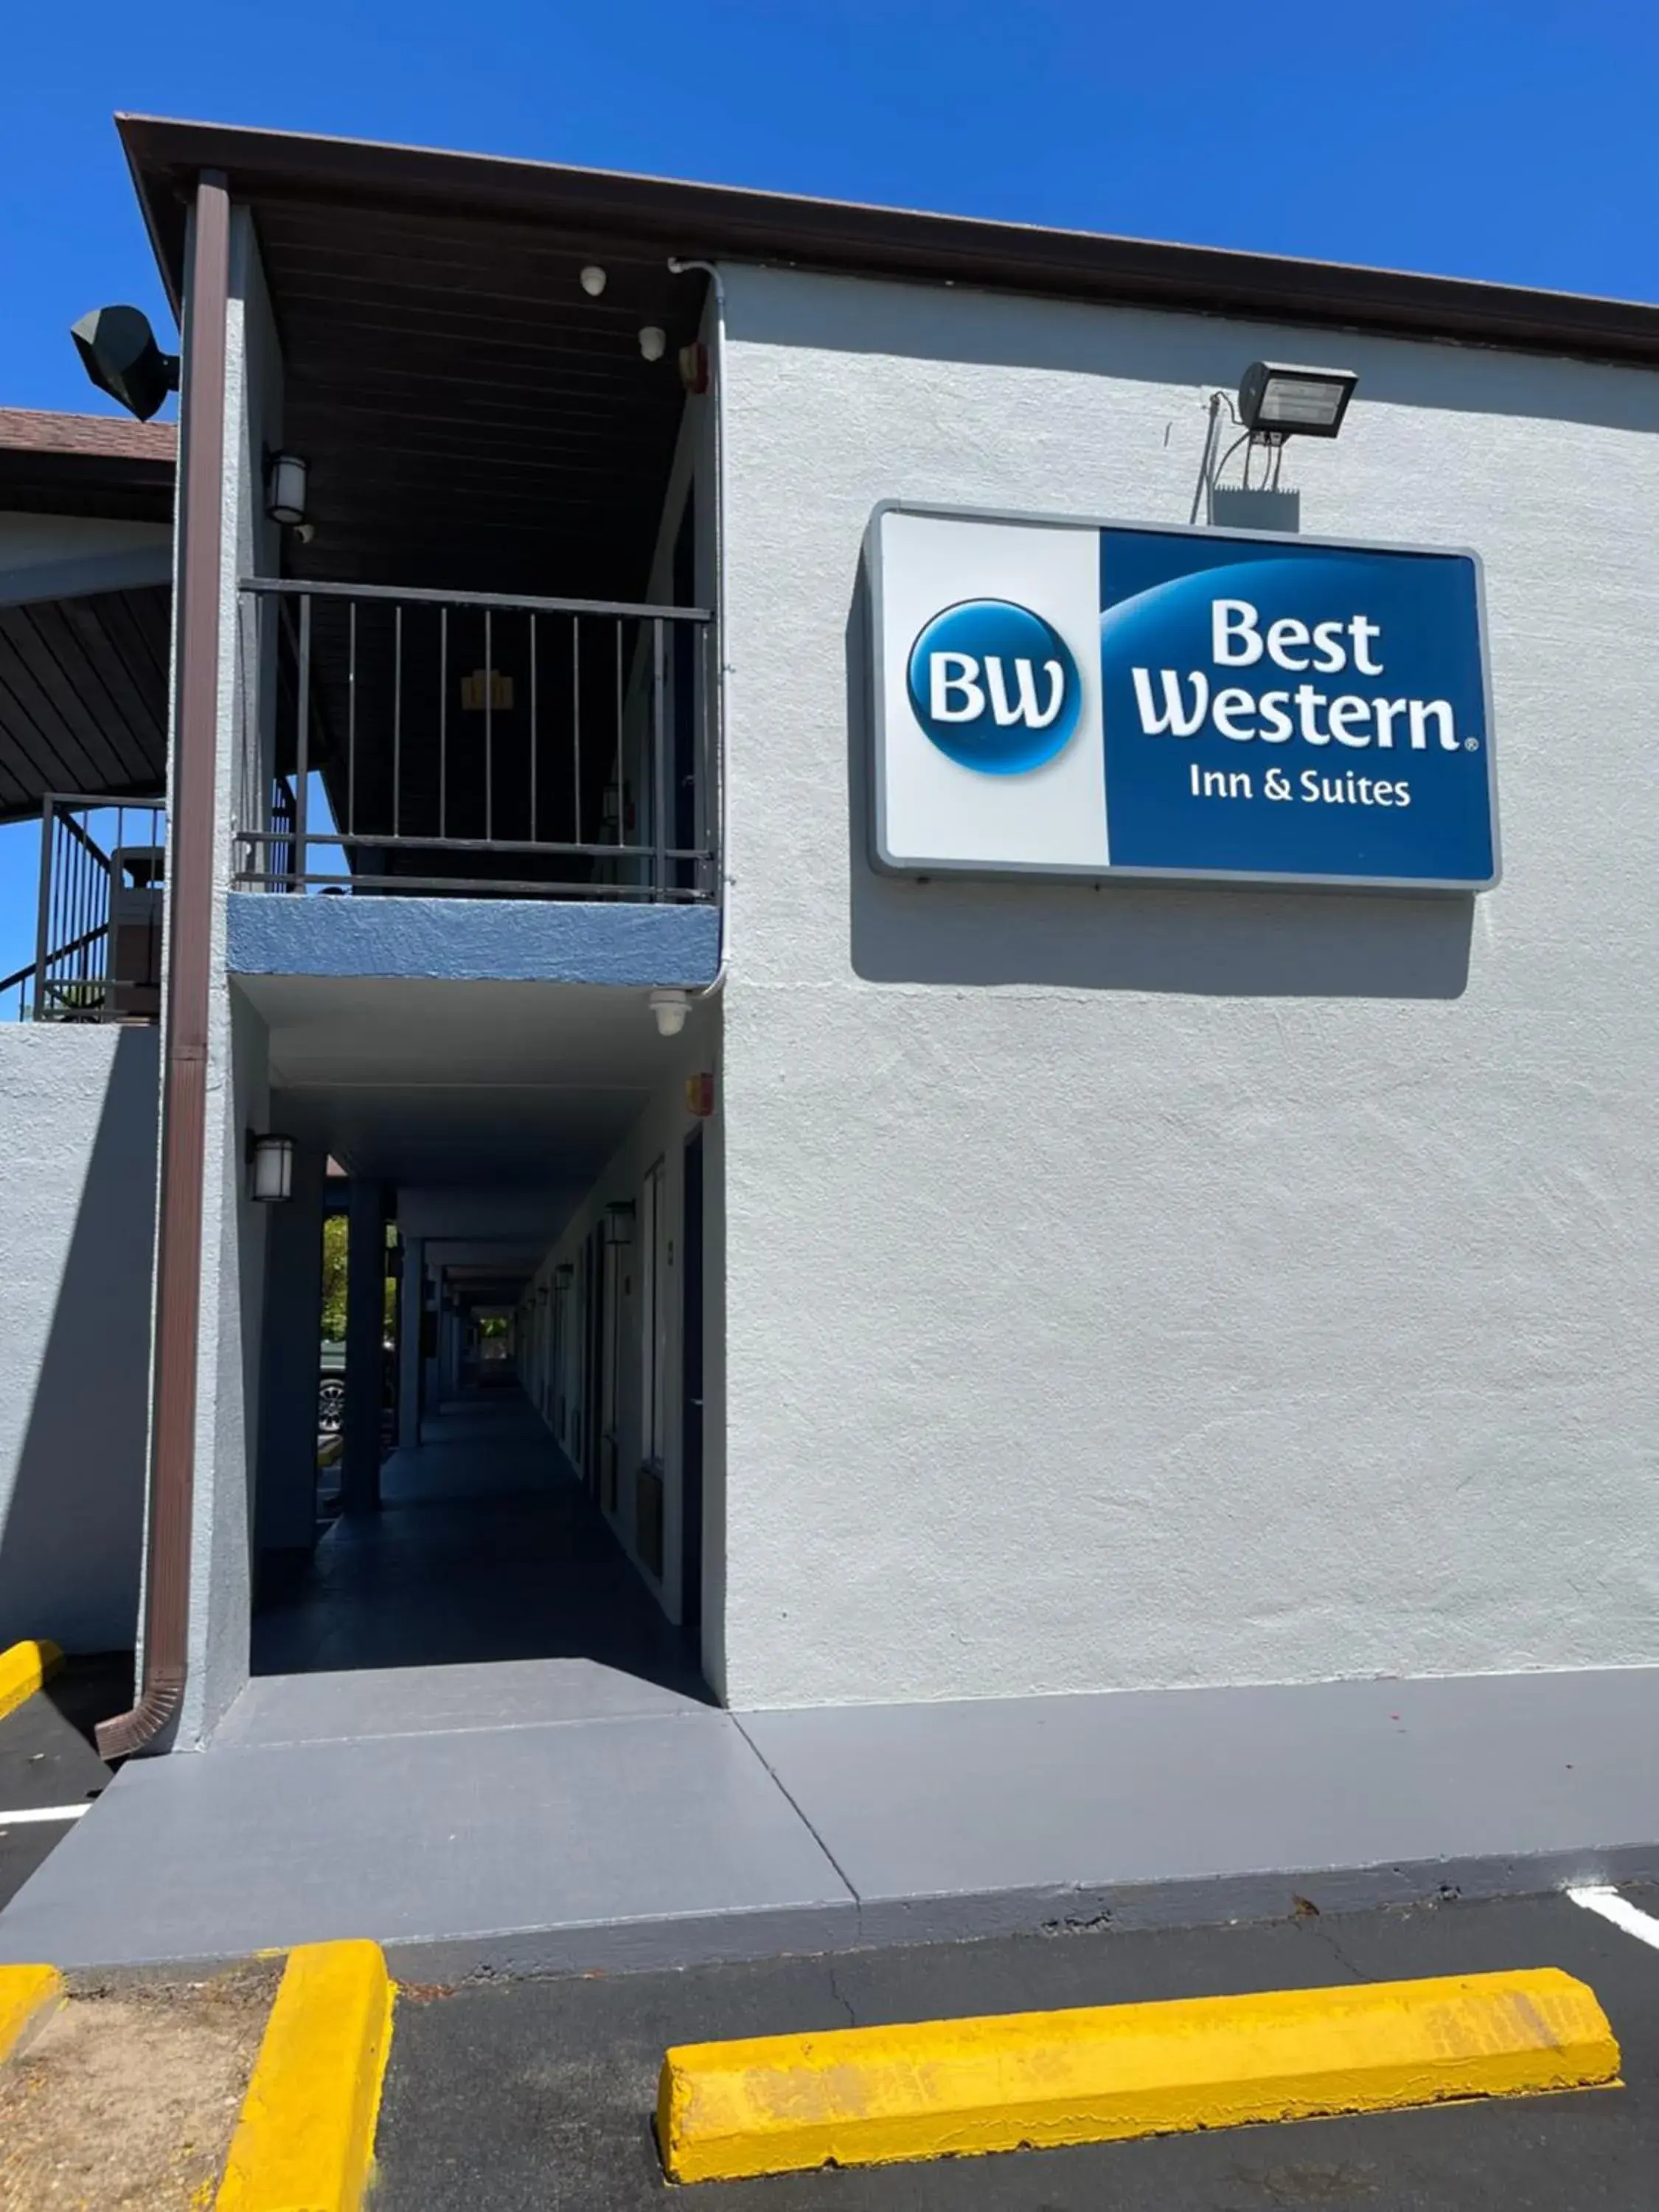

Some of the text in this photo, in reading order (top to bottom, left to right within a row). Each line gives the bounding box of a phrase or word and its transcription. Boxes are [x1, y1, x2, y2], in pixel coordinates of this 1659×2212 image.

[1211, 599, 1384, 675] Best
[929, 651, 1064, 728] BW
[1132, 667, 1460, 751] Western
[1190, 764, 1411, 807] Inn & Suites
